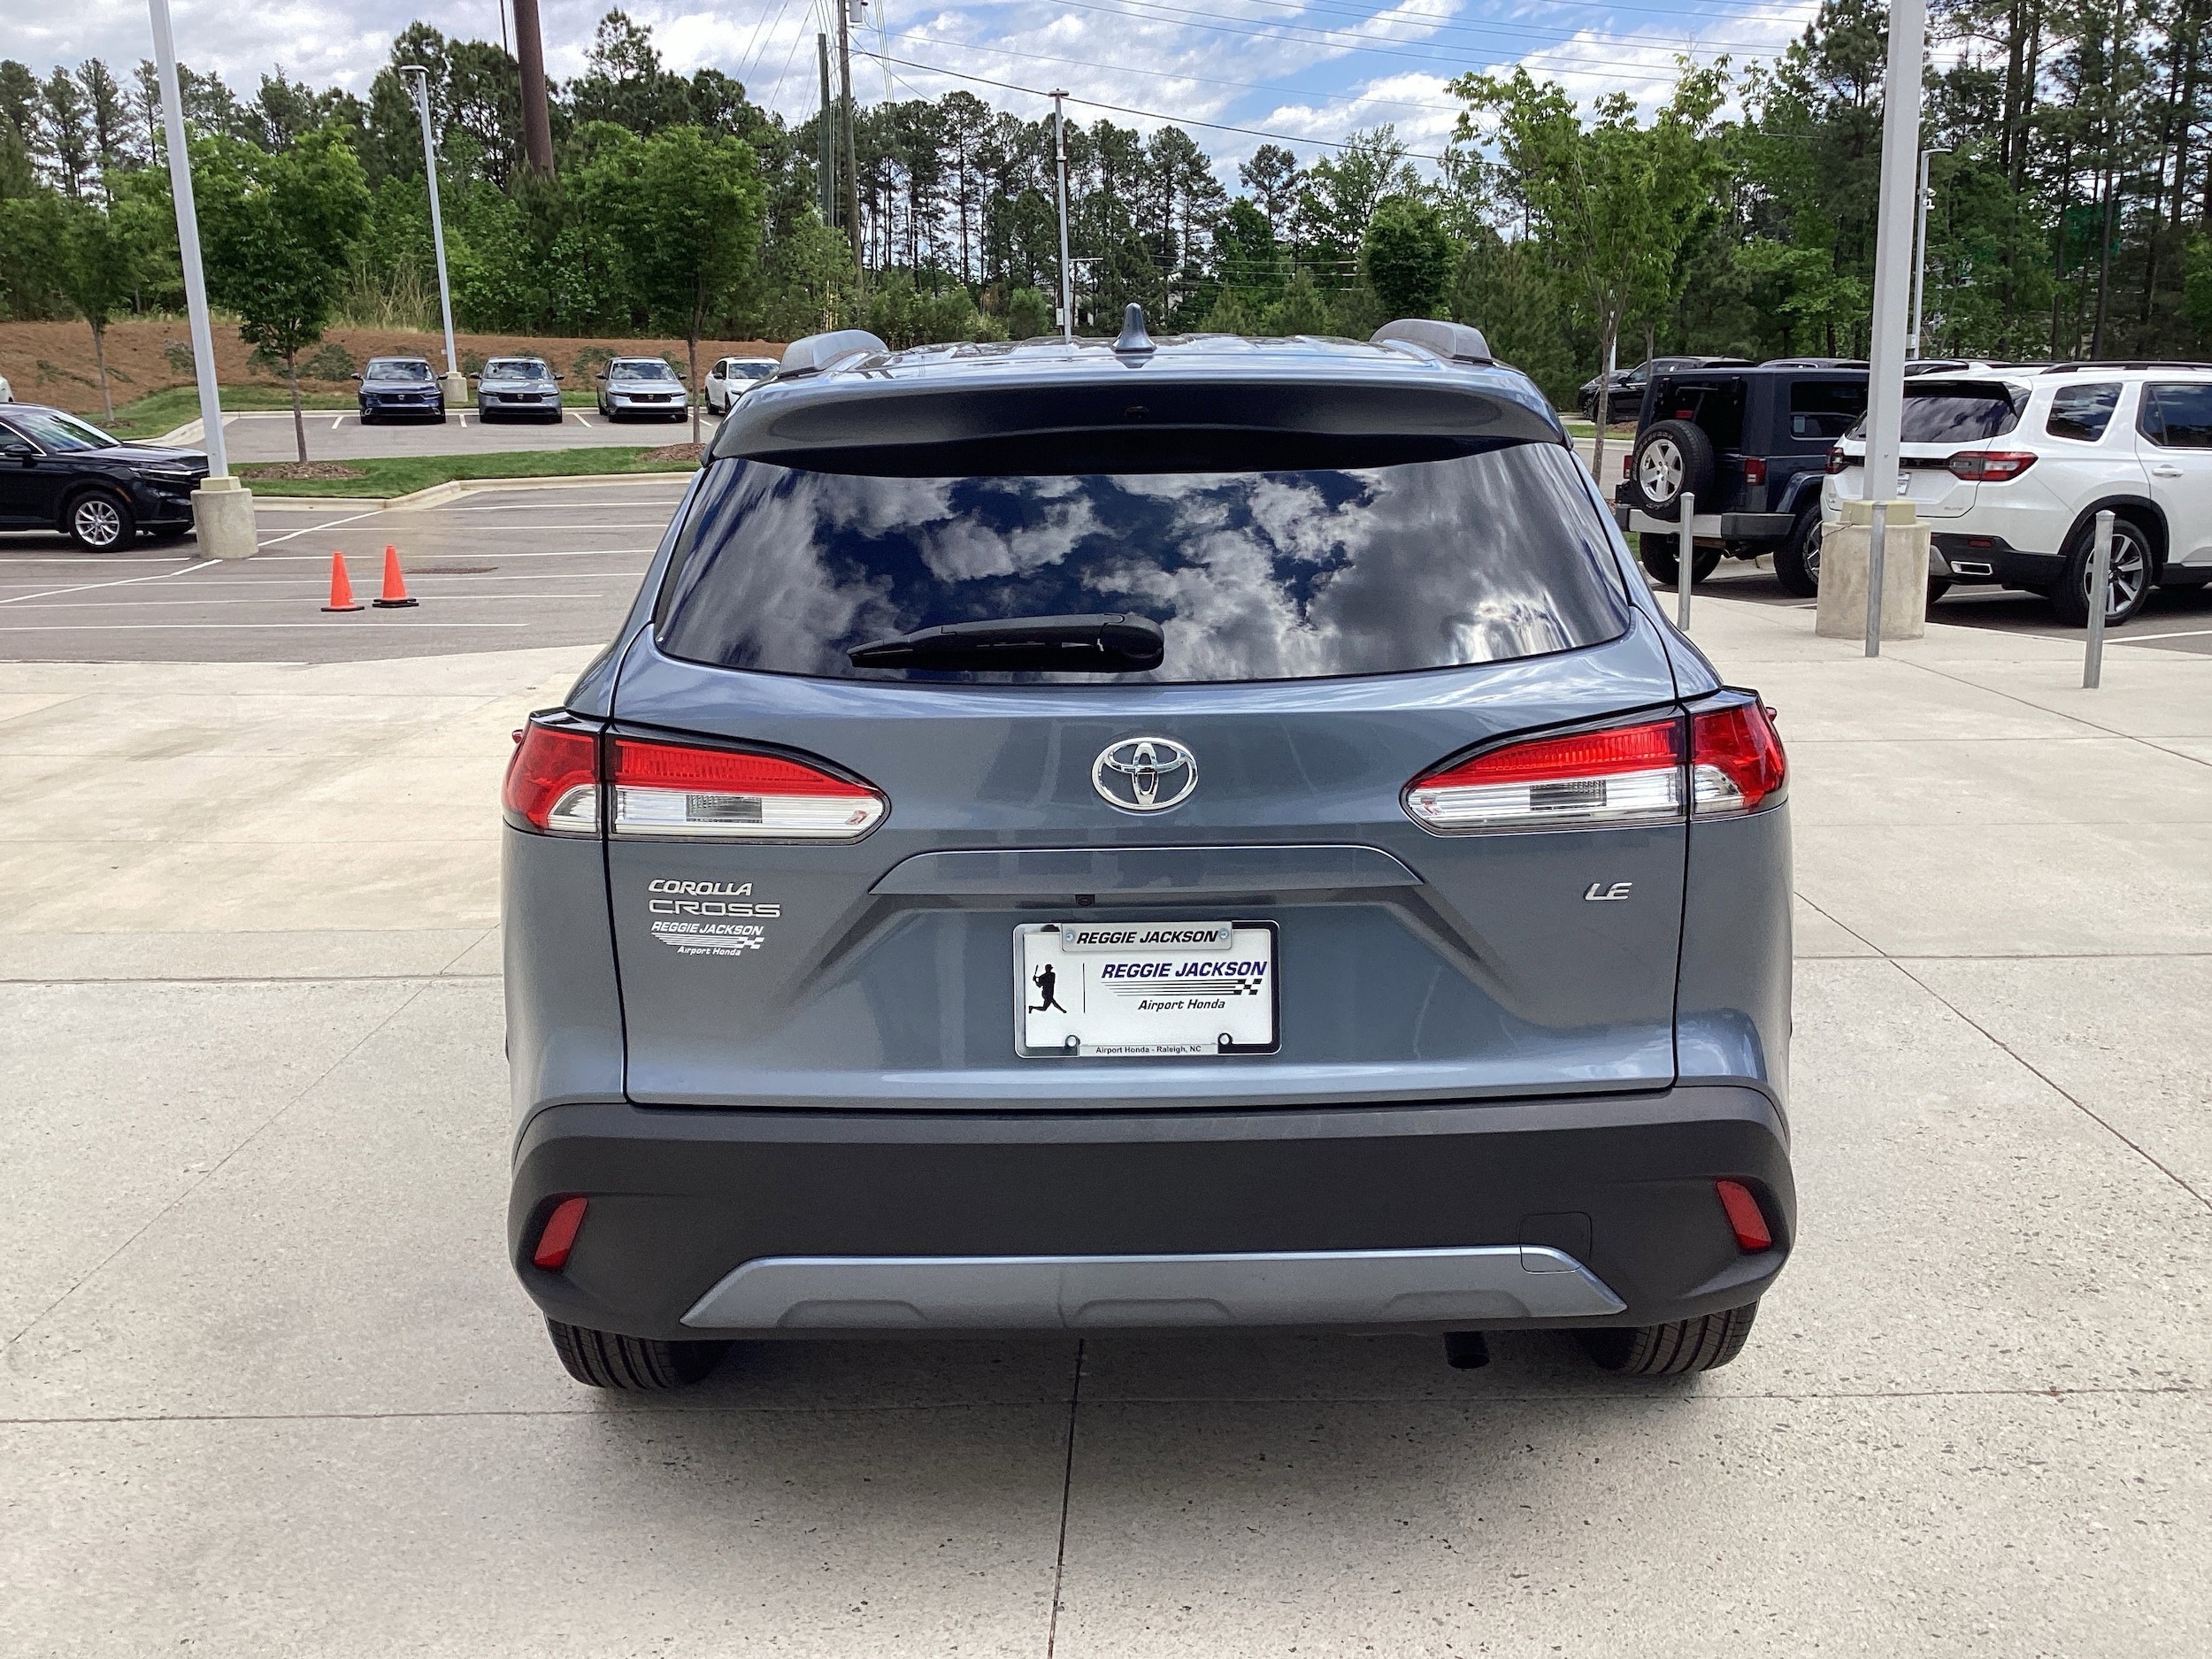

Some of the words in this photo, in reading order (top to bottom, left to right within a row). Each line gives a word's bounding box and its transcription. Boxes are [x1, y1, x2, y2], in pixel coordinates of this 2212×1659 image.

[648, 879, 753, 896] COROLLA
[1583, 881, 1633, 901] LE
[649, 899, 781, 918] CROSS
[651, 921, 700, 933] REGGIE
[699, 923, 764, 936] JACKSON
[1076, 931, 1137, 944] REGGIE
[1139, 930, 1219, 943] JACKSON
[677, 946, 710, 956] Airport
[712, 947, 741, 956] Honda
[1101, 963, 1172, 979] REGGIE
[1174, 961, 1267, 978] JACKSON
[1137, 999, 1184, 1012] Airport
[1187, 998, 1225, 1010] Honda
[1095, 1046, 1123, 1055] Airport
